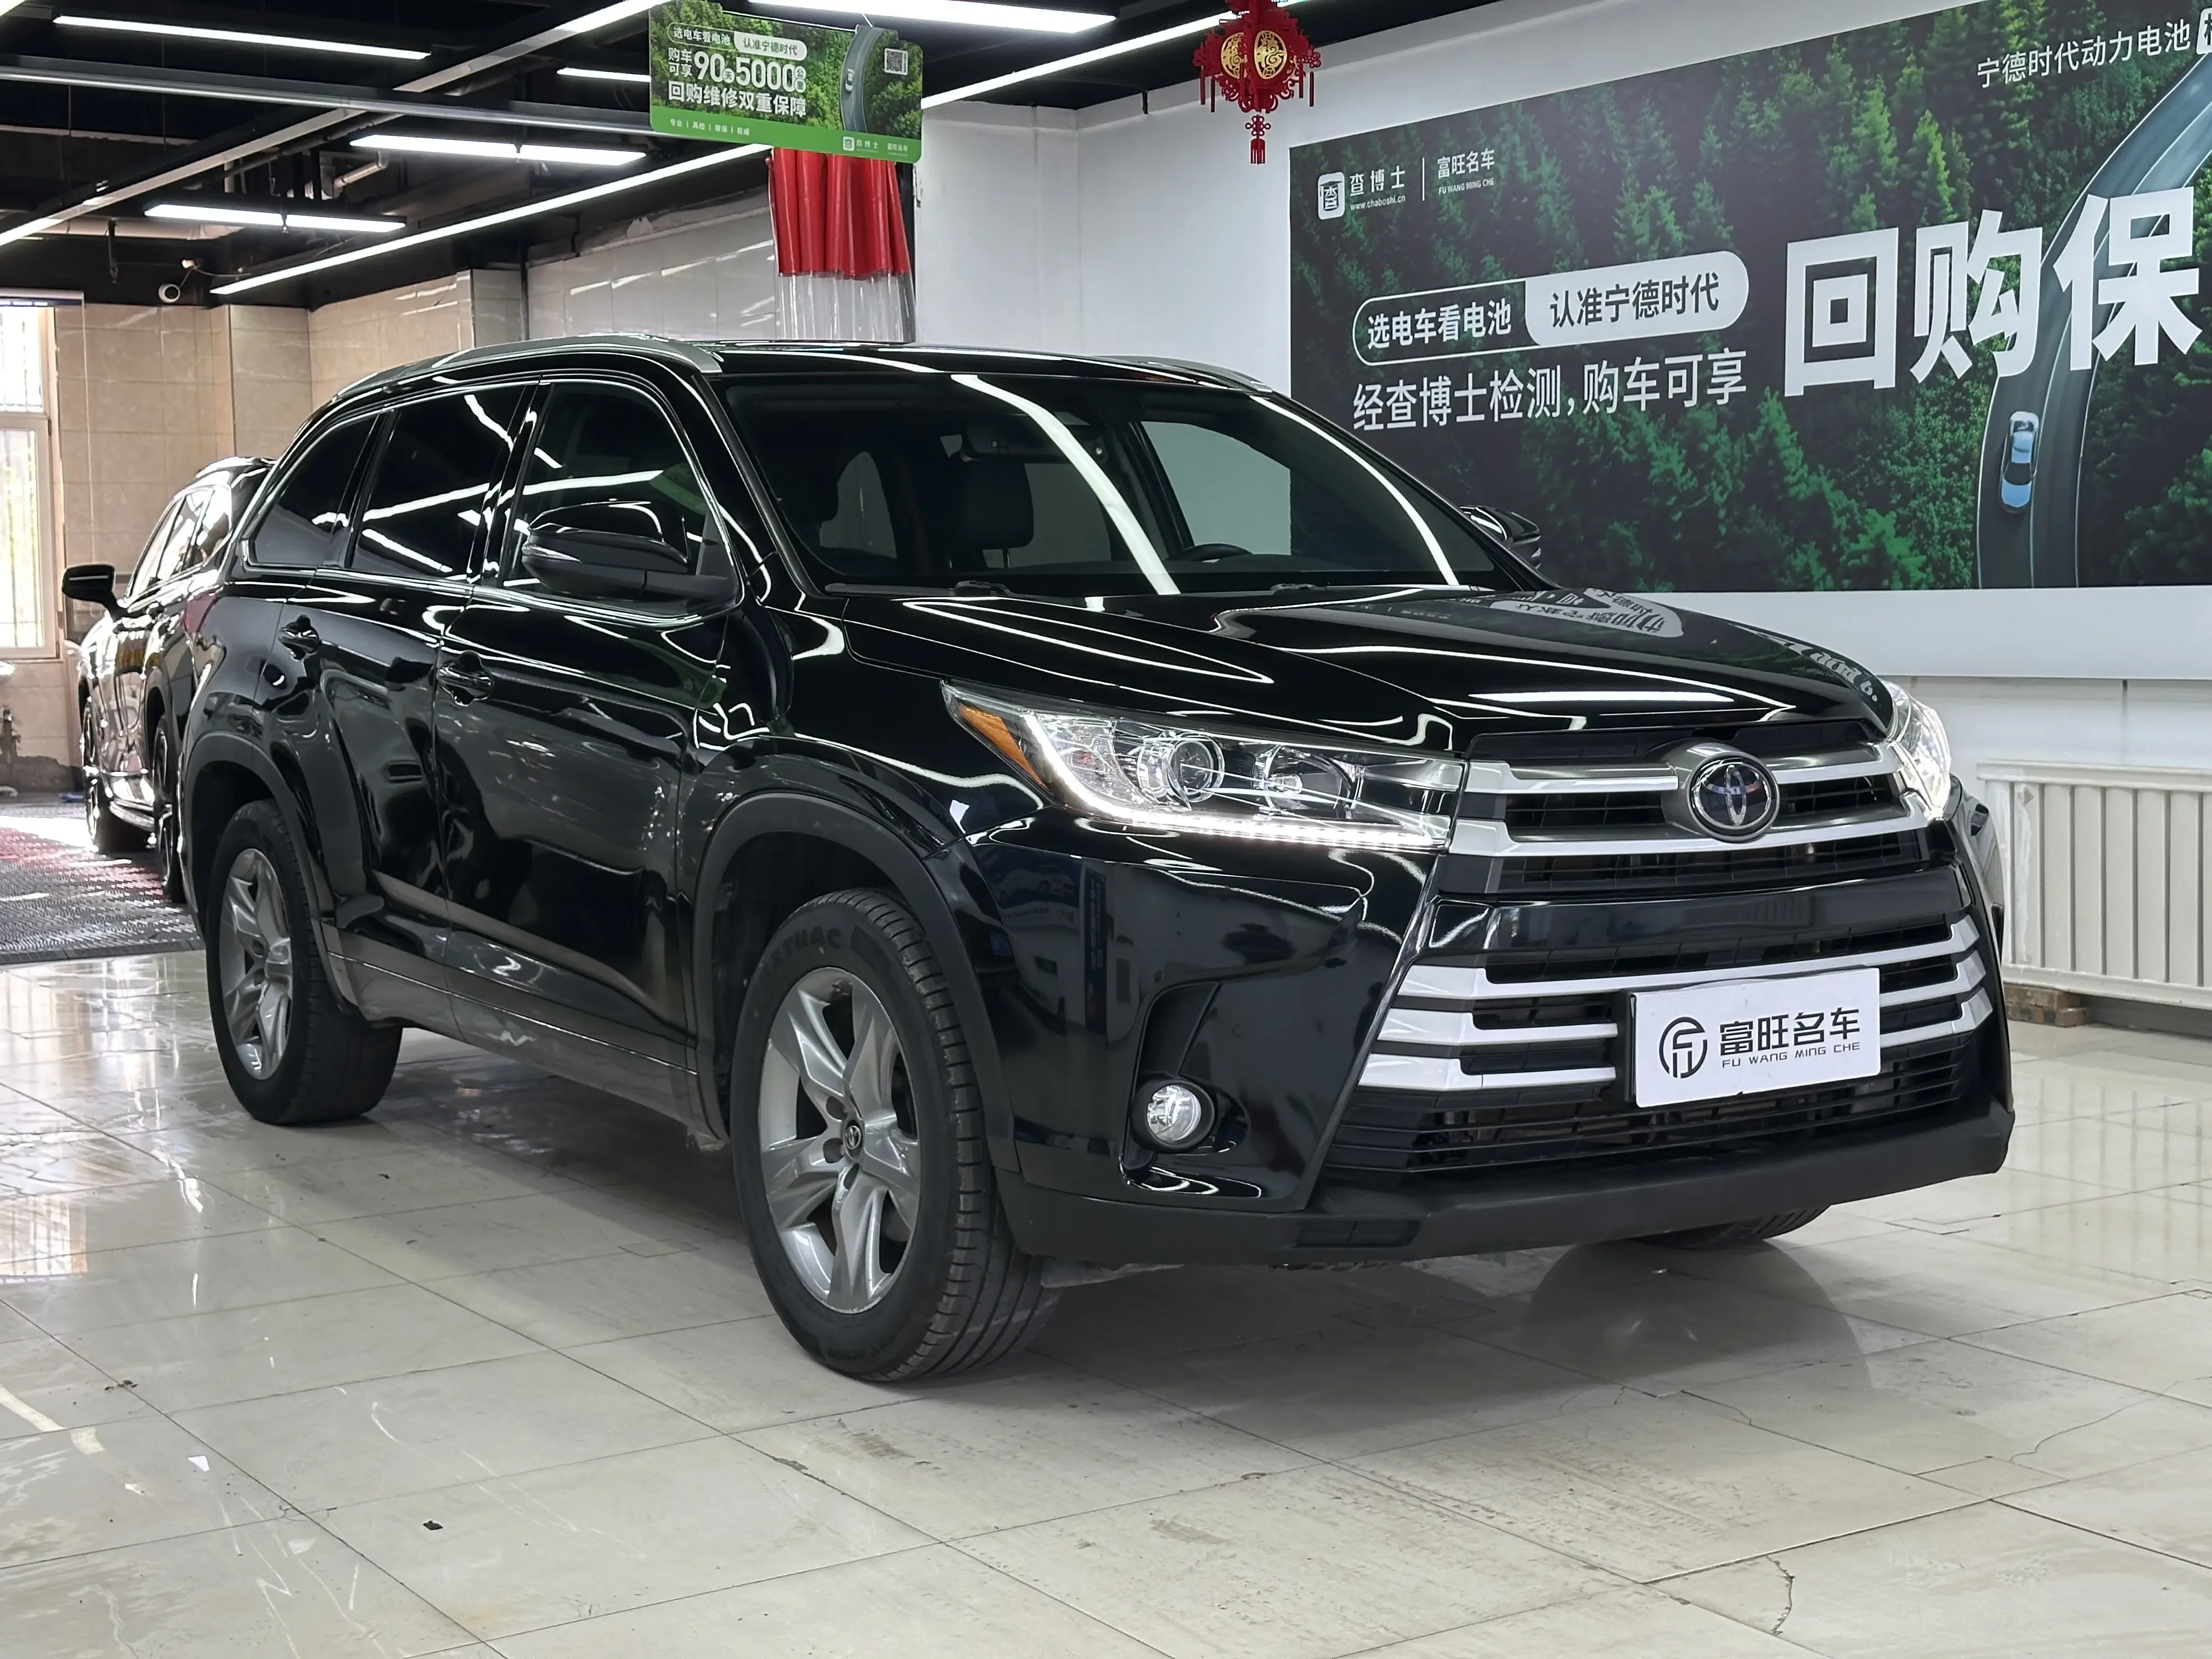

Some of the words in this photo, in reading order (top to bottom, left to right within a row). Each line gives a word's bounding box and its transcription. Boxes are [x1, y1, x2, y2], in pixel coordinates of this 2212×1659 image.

[674, 27, 730, 45] 选电车看电池
[743, 38, 797, 55] 认准宁德时代
[1977, 19, 2191, 88] 宁德时代动力电池
[668, 81, 806, 117] 回购维修双重保障
[1437, 148, 1495, 179] 富旺名车
[1350, 194, 1406, 211] www.chaboshi.cn
[1438, 185, 1447, 195] FU
[1447, 182, 1465, 193] WANG
[1550, 271, 1719, 329] 认准宁德时代
[1784, 187, 2202, 397] 回购保
[1367, 298, 1512, 350] 选电车看电池
[1719, 1007, 1860, 1056] 富旺名车
[1722, 1058, 1741, 1069] FU
[1749, 1052, 1787, 1065] WANG
[1795, 1046, 1826, 1059] MING
[1833, 1041, 1861, 1054] CHE
